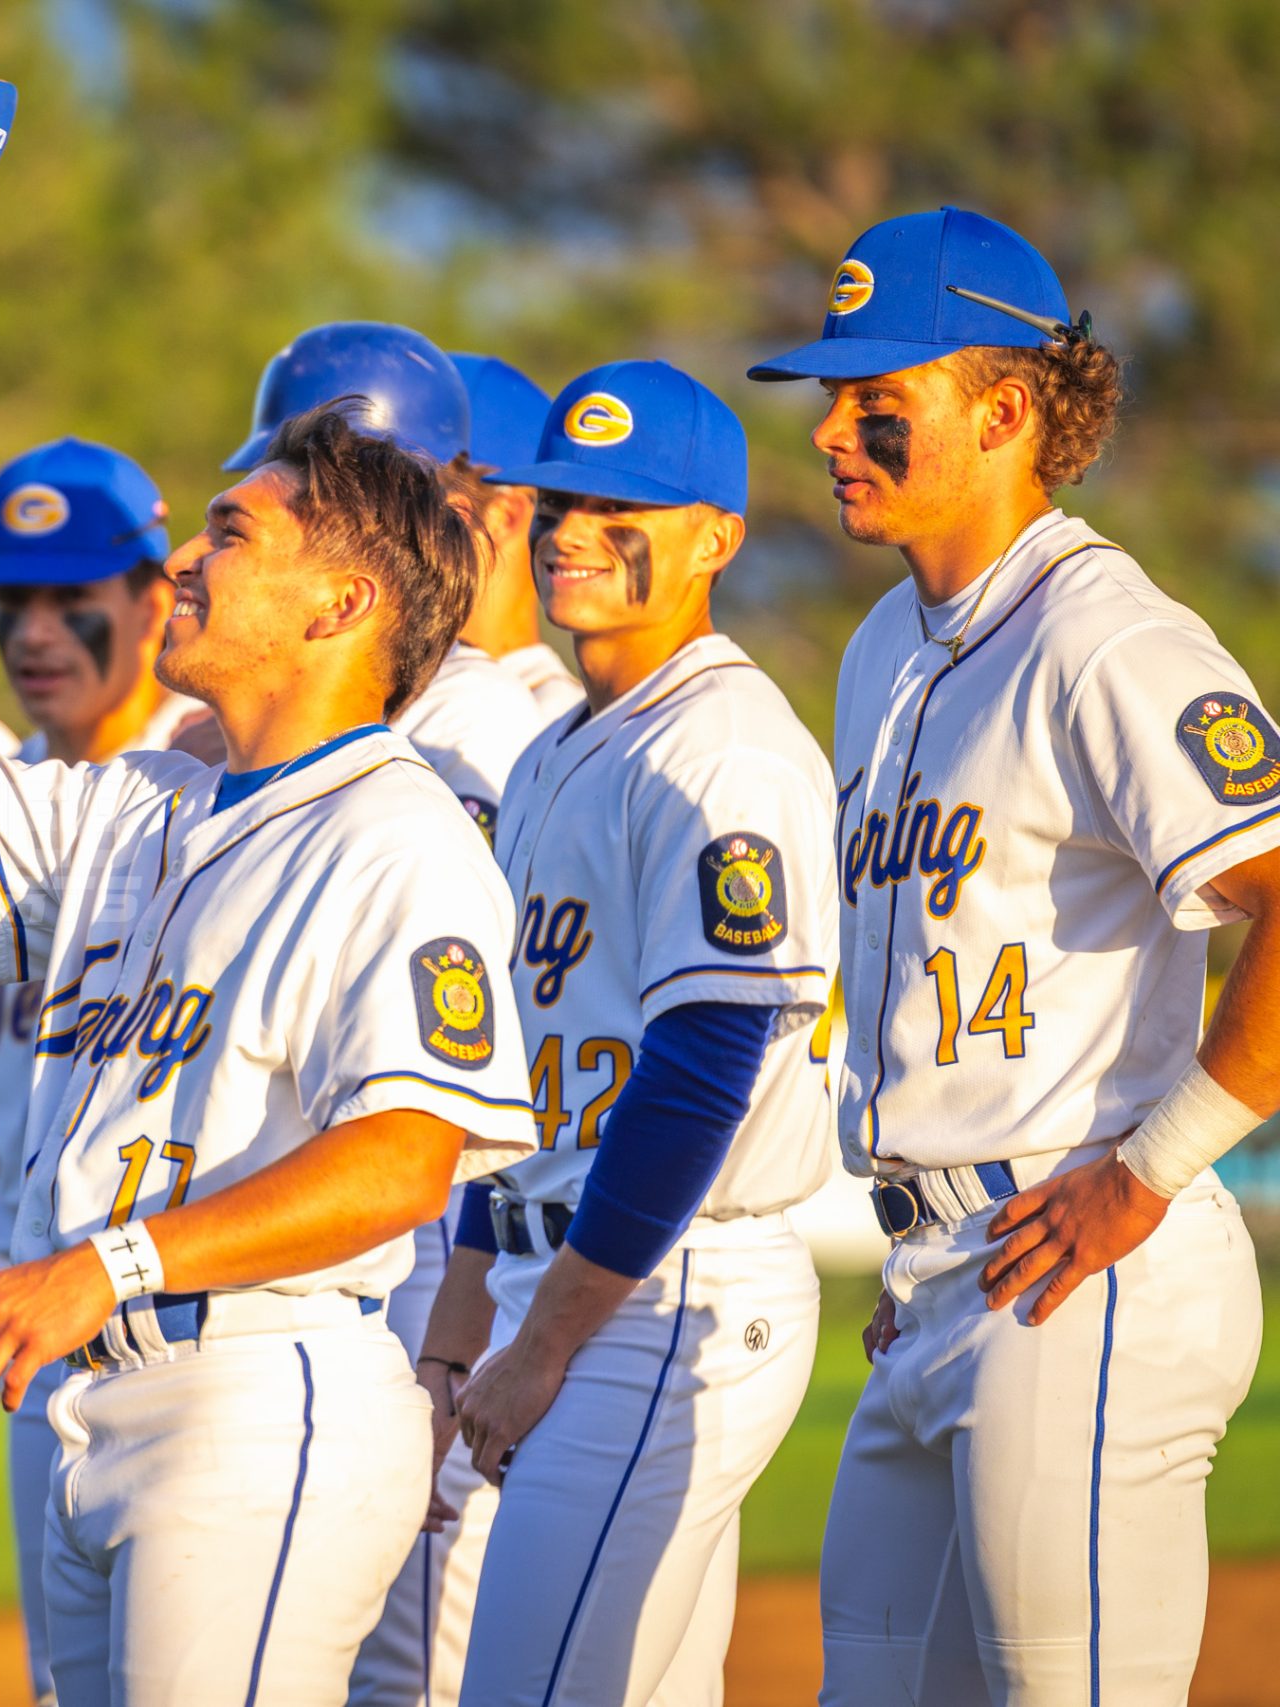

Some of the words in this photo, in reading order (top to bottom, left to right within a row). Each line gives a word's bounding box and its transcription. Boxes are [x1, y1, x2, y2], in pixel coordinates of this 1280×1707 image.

[828, 259, 875, 316] G
[564, 391, 634, 446] G
[2, 484, 70, 536] G
[1224, 762, 1280, 796] BASEBA
[713, 920, 783, 945] BASEBALL
[924, 941, 1036, 1067] 14
[529, 1034, 635, 1151] 42
[104, 1134, 197, 1229] 17
